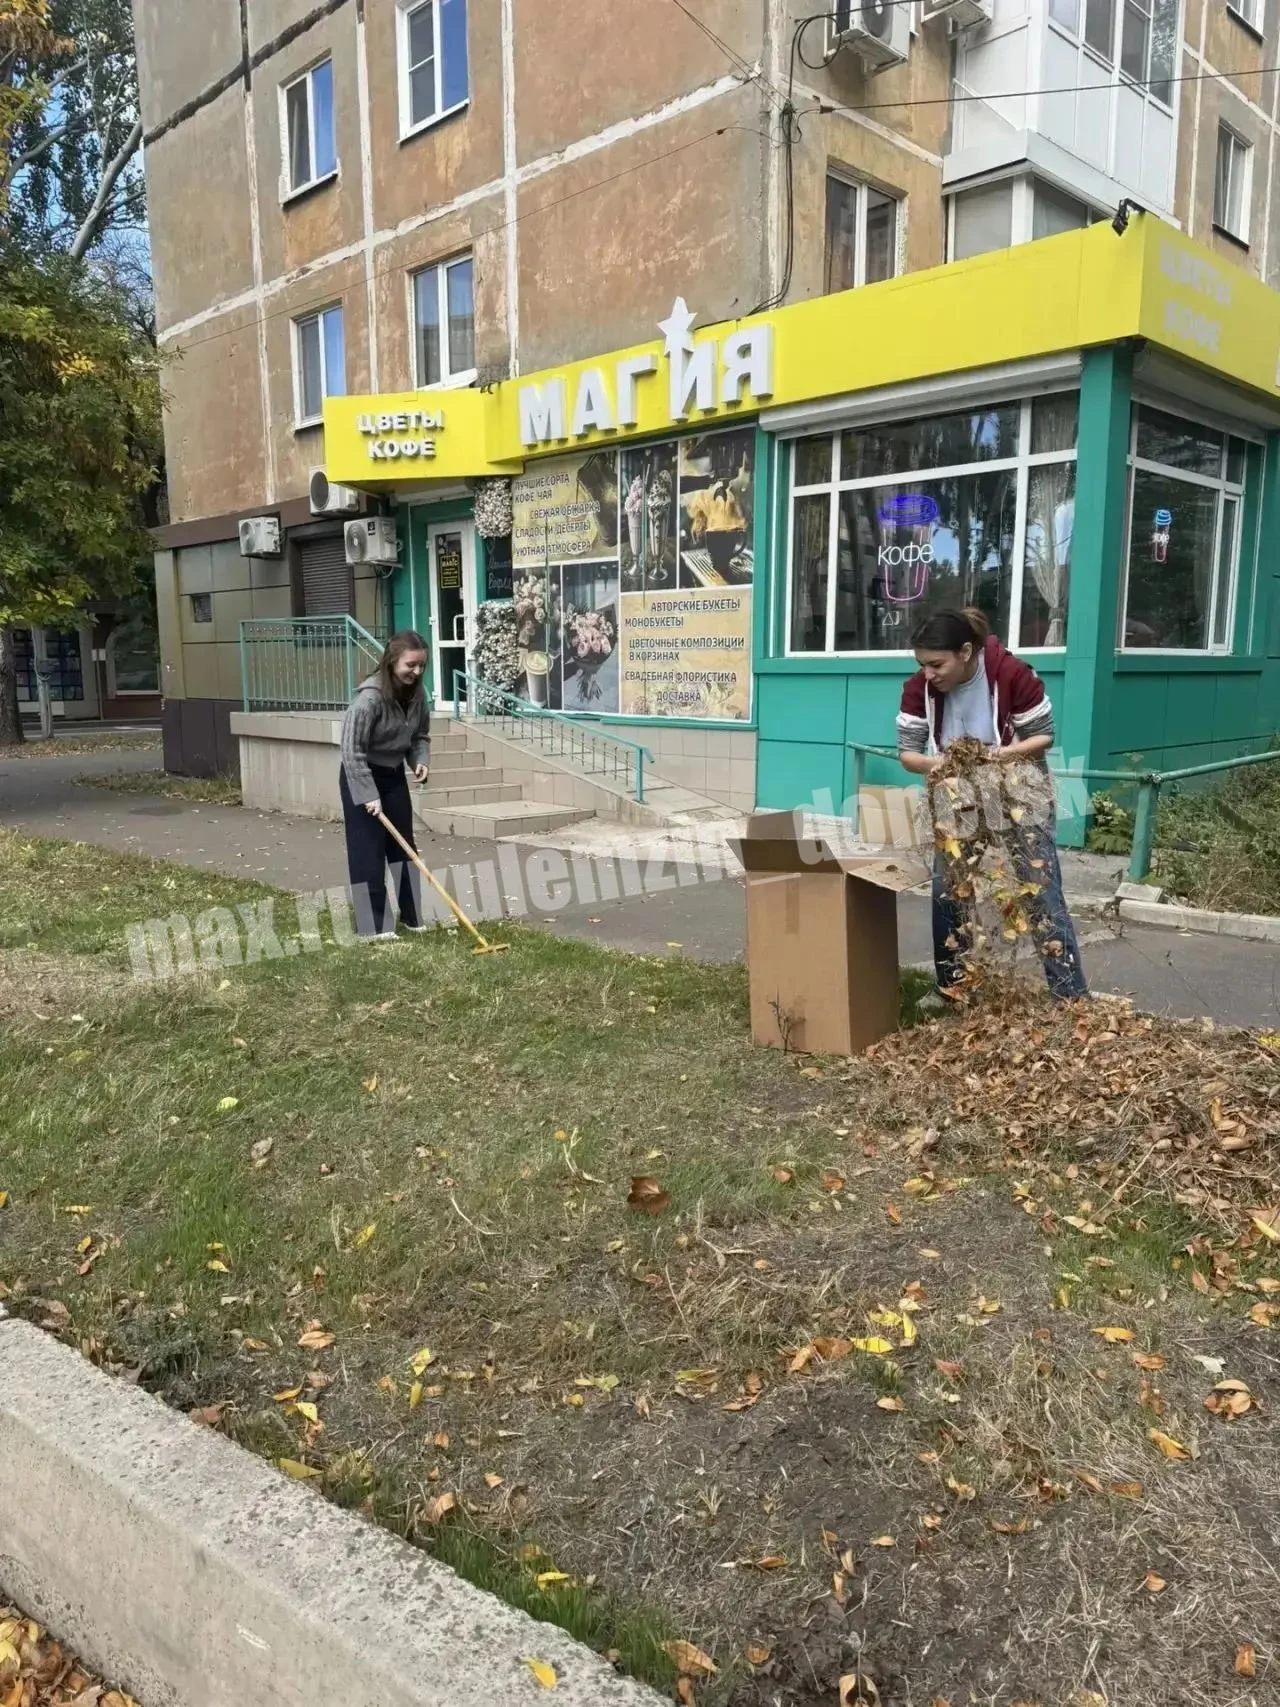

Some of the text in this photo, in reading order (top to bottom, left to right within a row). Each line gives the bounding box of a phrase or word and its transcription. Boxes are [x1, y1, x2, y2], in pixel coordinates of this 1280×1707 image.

[518, 319, 776, 447] МАГИЯ
[357, 409, 445, 436] ЦВЕТЫ
[368, 437, 437, 460] КОФЕ
[514, 473, 570, 490] ЛУЧШИЕ СОРТА
[514, 489, 553, 504] КОФЕ ЧАЯ
[530, 500, 601, 520] СВЕЖАЯ ОБЖАРКА
[515, 521, 591, 539] СЛАДОСИ ДЕСЕРТЫ
[515, 545, 545, 557] УЮТНАЯ
[878, 541, 935, 568] кофе
[651, 598, 741, 612] АВТОРСКИЕ БУКЕТЫ
[624, 616, 684, 628] МОНОБУКЕТЫ
[629, 637, 745, 649] ЦВЕТОЧНЫЕ КОМПОЗИЦИИ
[629, 651, 680, 661] В КОРЗИНАХ
[624, 670, 737, 682] СВАДЕБНАЯ ФЛОРИСТИКА
[656, 690, 701, 702] ДОСТАВКА
